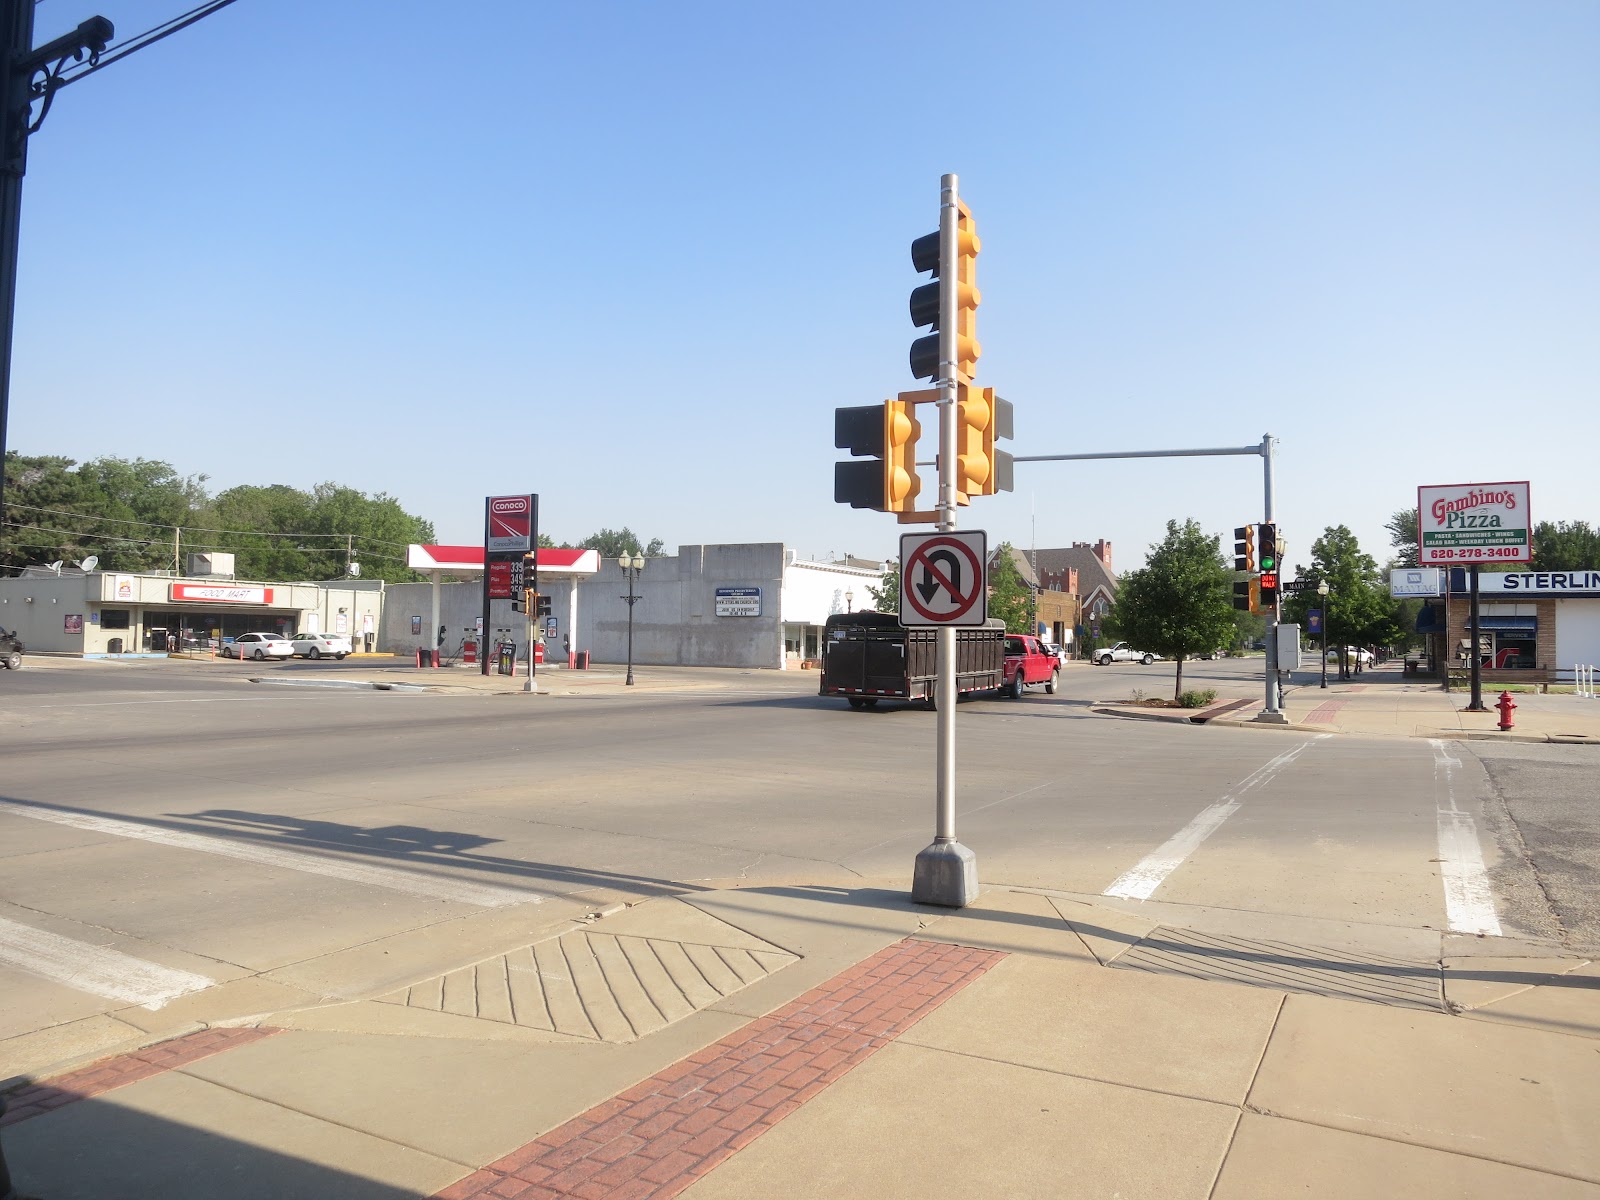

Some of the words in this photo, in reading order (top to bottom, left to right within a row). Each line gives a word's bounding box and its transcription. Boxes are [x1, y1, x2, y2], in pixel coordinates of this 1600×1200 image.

[1431, 489, 1516, 525] Gambino's
[1446, 511, 1502, 529] Pizza
[1430, 547, 1520, 559] 620-278-3400
[510, 562, 523, 573] 339
[199, 589, 225, 597] FOOD
[226, 590, 251, 599] MART
